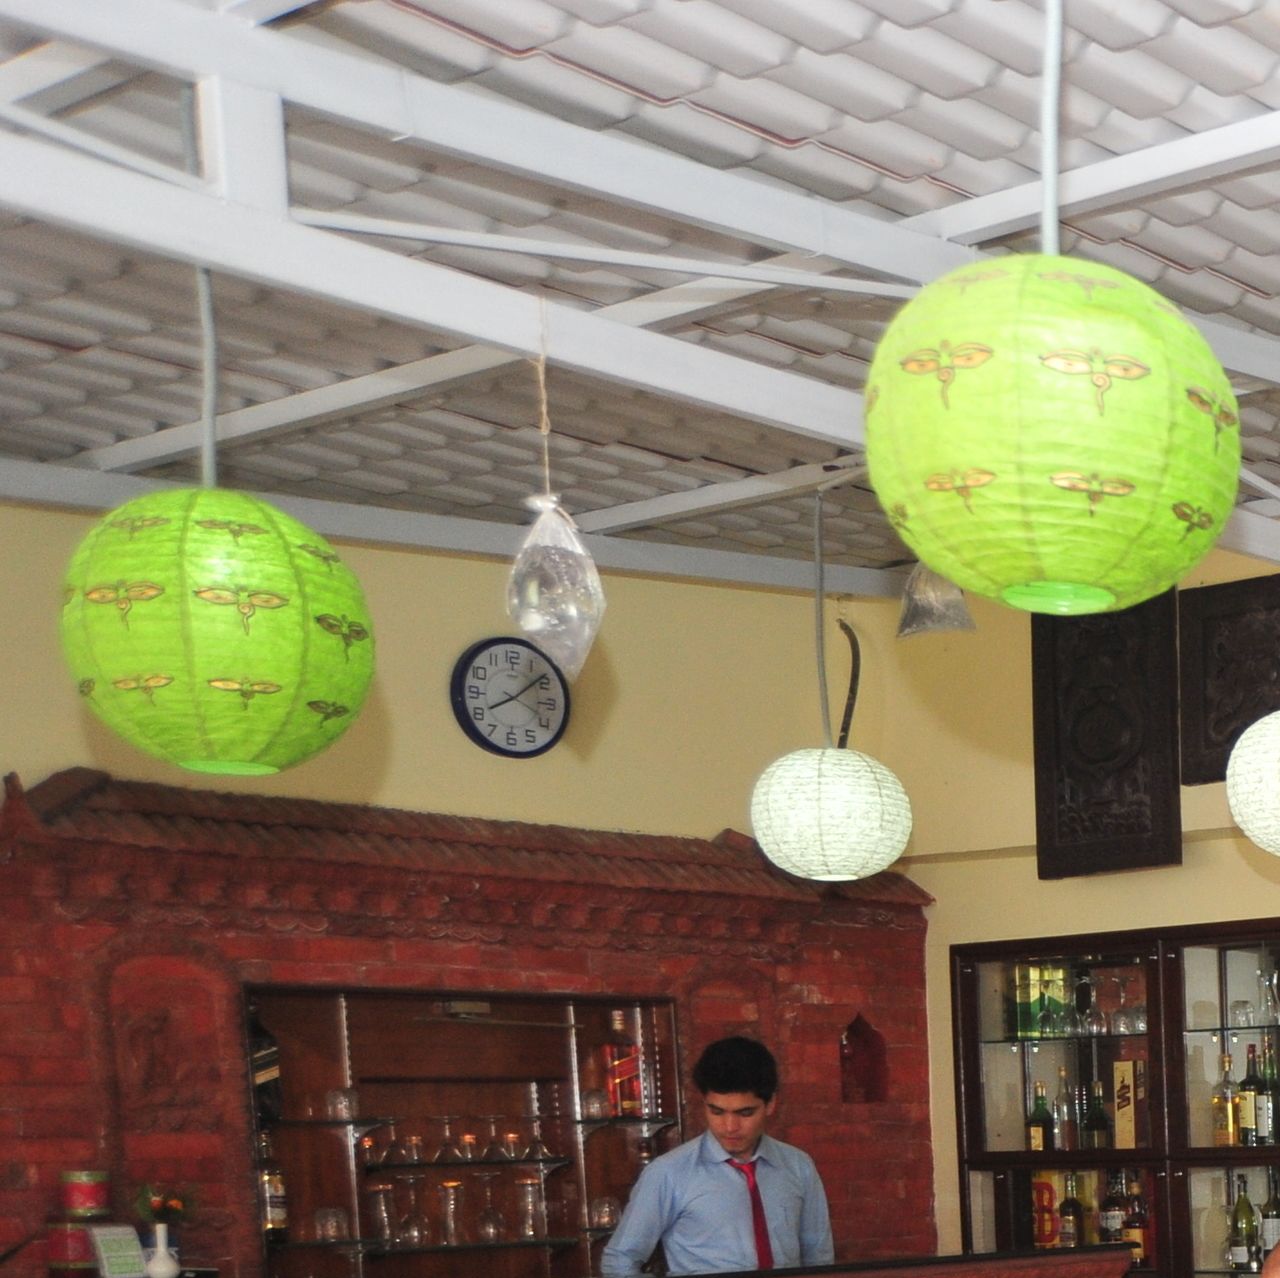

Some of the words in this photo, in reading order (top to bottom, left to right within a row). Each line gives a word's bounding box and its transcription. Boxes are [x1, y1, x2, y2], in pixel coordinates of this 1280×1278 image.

[490, 654, 498, 666] 11
[505, 650, 520, 665] 12
[472, 665, 487, 680] 10
[529, 660, 533, 673] 1
[469, 685, 479, 699] 9
[546, 698, 556, 711] 3
[474, 707, 484, 720] 8
[488, 724, 498, 737] 7
[539, 718, 550, 730] 4
[506, 732, 517, 745] 6
[525, 729, 536, 743] 5
